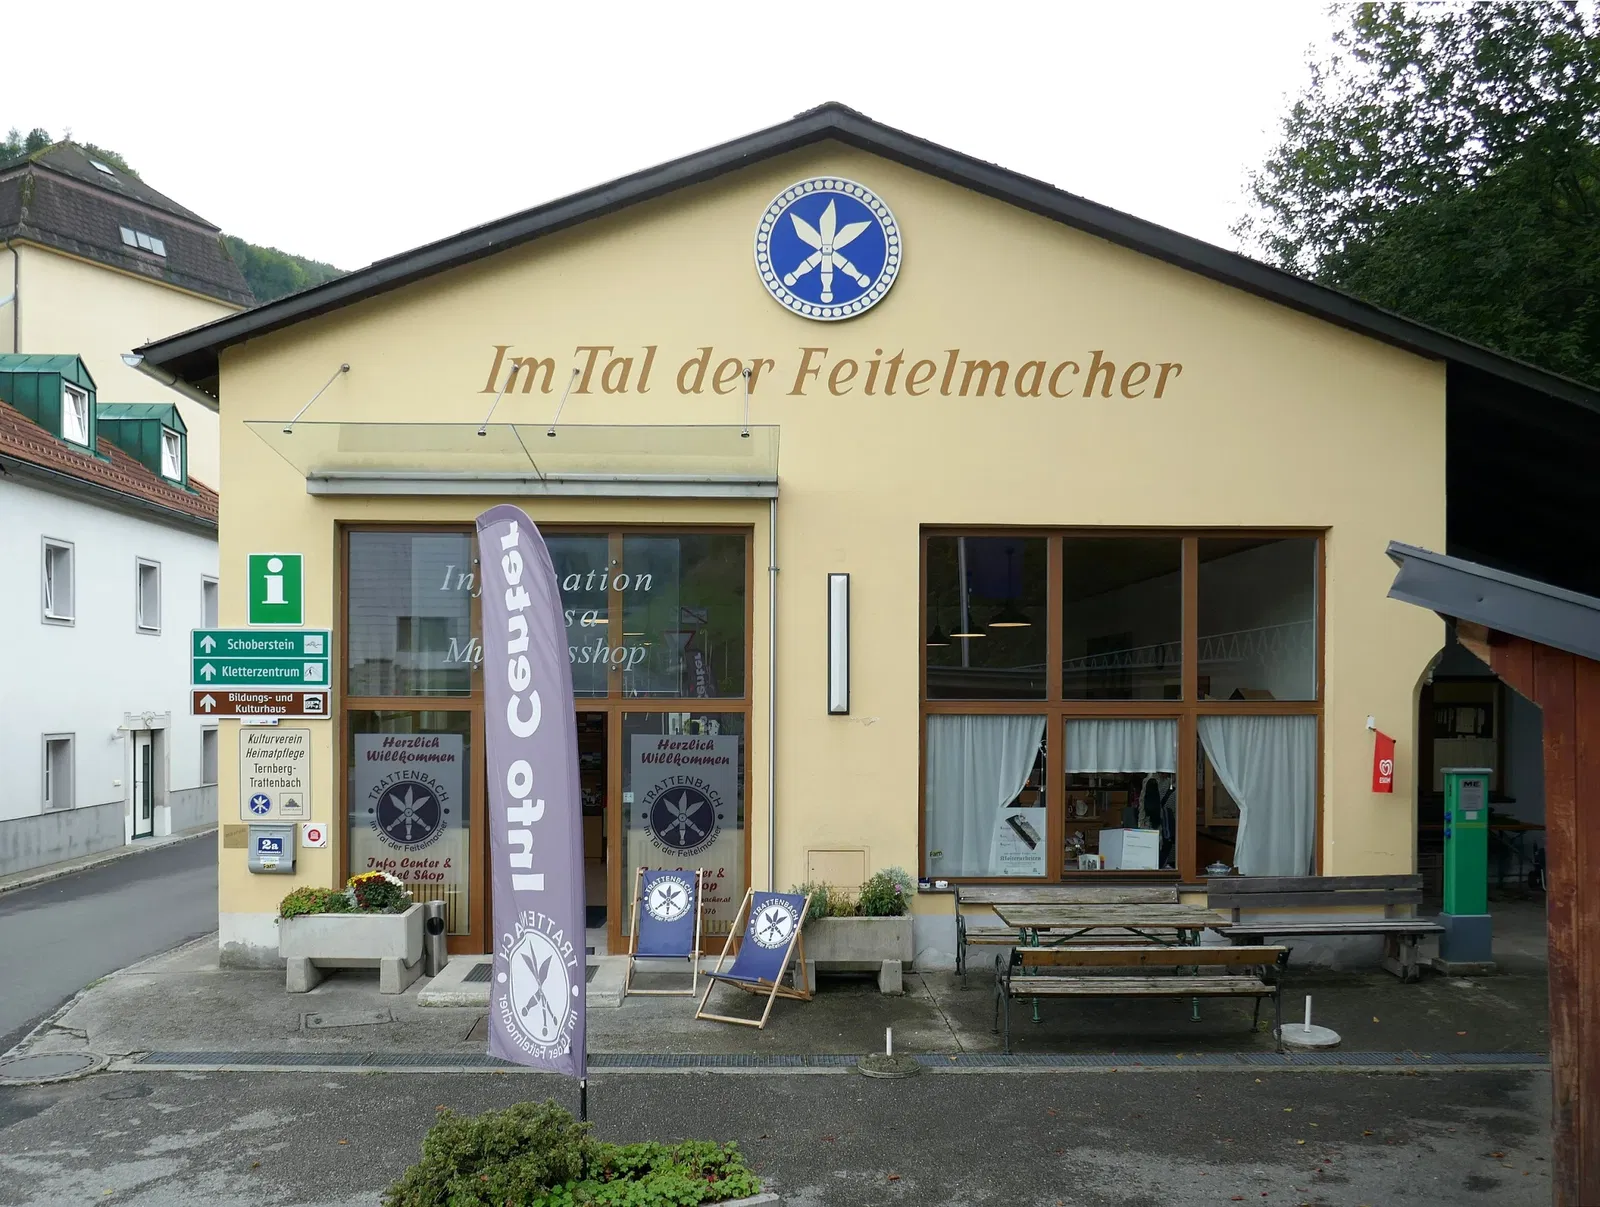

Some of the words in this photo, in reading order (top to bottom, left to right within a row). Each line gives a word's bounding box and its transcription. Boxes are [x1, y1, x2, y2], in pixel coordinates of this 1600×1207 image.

[478, 345, 556, 395] Im
[571, 345, 658, 395] Tal
[676, 346, 774, 395] der
[786, 346, 1183, 399] Feitelmacher
[227, 638, 294, 651] Schoberstein
[222, 665, 300, 678] Kletterzentrum
[228, 693, 272, 704] Bildungs-
[275, 693, 293, 702] und
[235, 704, 286, 713] Kulturhaus
[248, 734, 303, 745] Kulturverein
[382, 737, 440, 748] Herzlich
[657, 739, 714, 751] Herzlich
[245, 748, 305, 759] Heimatpflege
[366, 750, 455, 764] Willkommen
[641, 753, 730, 766] Willkommen
[253, 763, 296, 776] Ternberg-
[249, 777, 301, 788] Trattenbach
[368, 770, 449, 802] TRATTENBACH
[642, 775, 724, 808] TRATTENBACH
[376, 831, 387, 844] Tal
[387, 841, 402, 851] der
[404, 820, 448, 852] Feitelmacher
[650, 835, 661, 849] Tal
[661, 846, 676, 857] der
[677, 825, 722, 857] Feitelmacher
[261, 840, 279, 850] 2a
[366, 857, 396, 870] Info
[400, 857, 440, 868] Center
[444, 857, 452, 868] &
[413, 870, 444, 882] Shop
[644, 875, 693, 895] TRATTENBACH
[752, 898, 799, 921] TRATTENBACH
